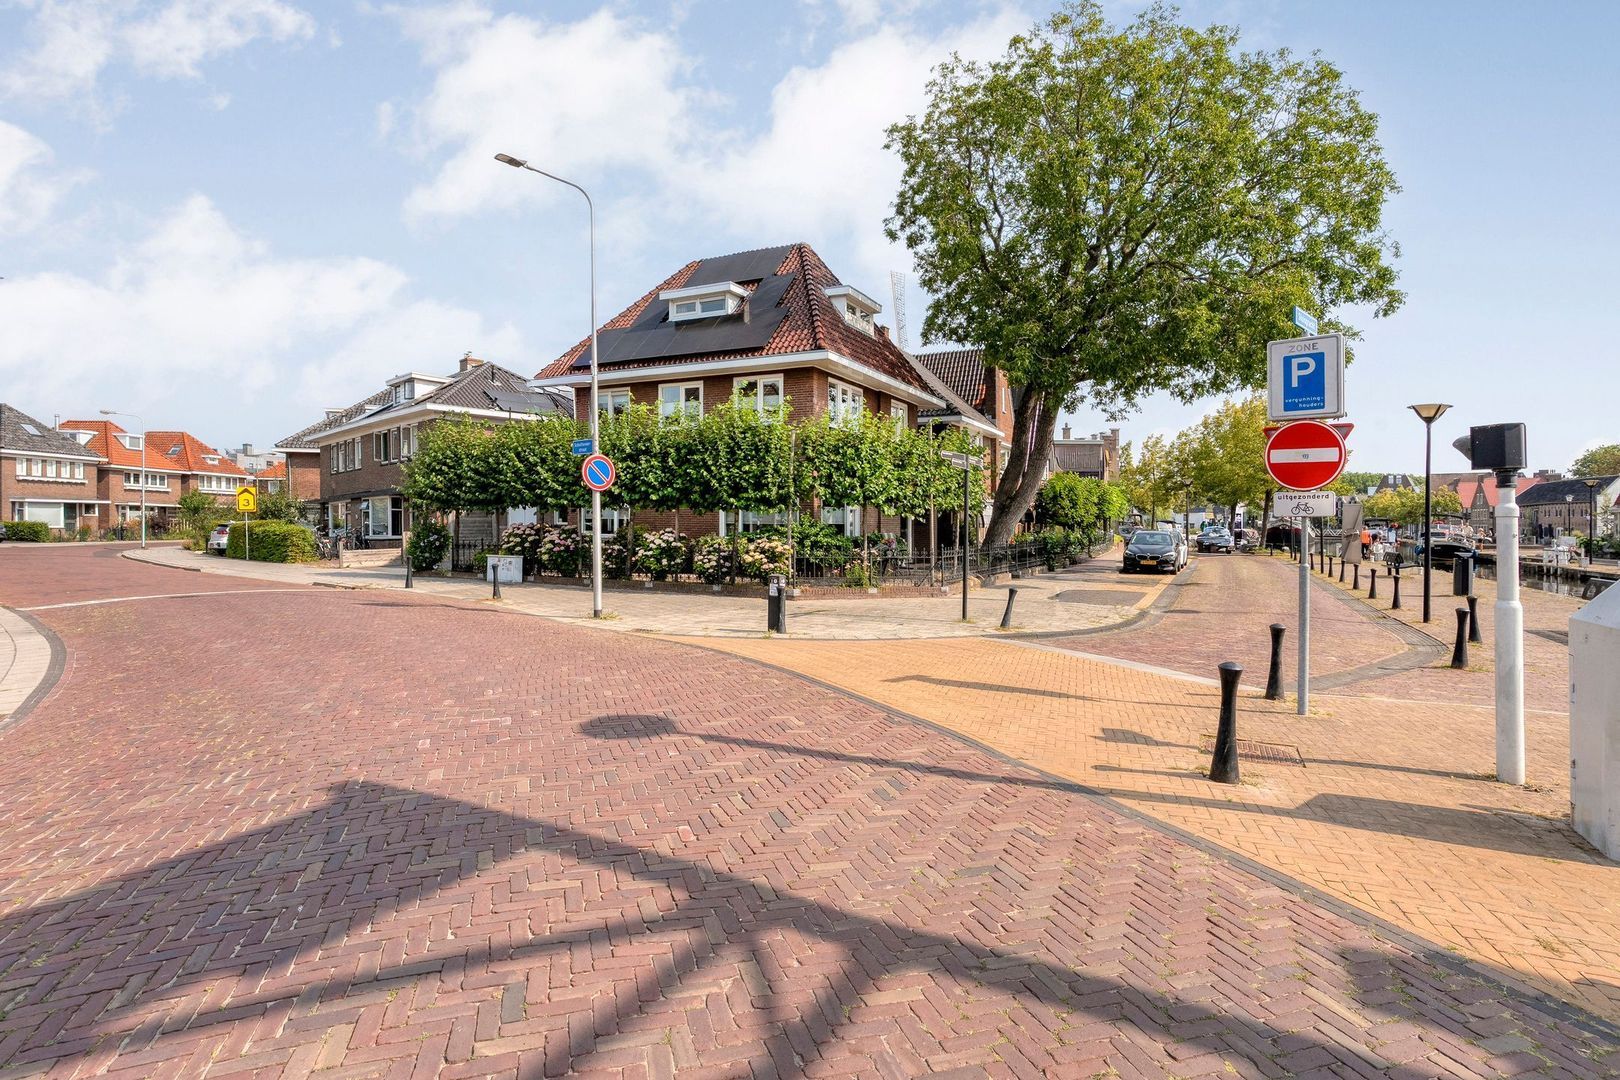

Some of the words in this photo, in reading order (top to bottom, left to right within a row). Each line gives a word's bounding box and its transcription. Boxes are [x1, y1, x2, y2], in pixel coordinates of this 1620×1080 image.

[1289, 342, 1319, 353] ZONE
[1291, 357, 1316, 388] P
[243, 498, 250, 507] 3
[1277, 494, 1330, 502] uitgezonderd
